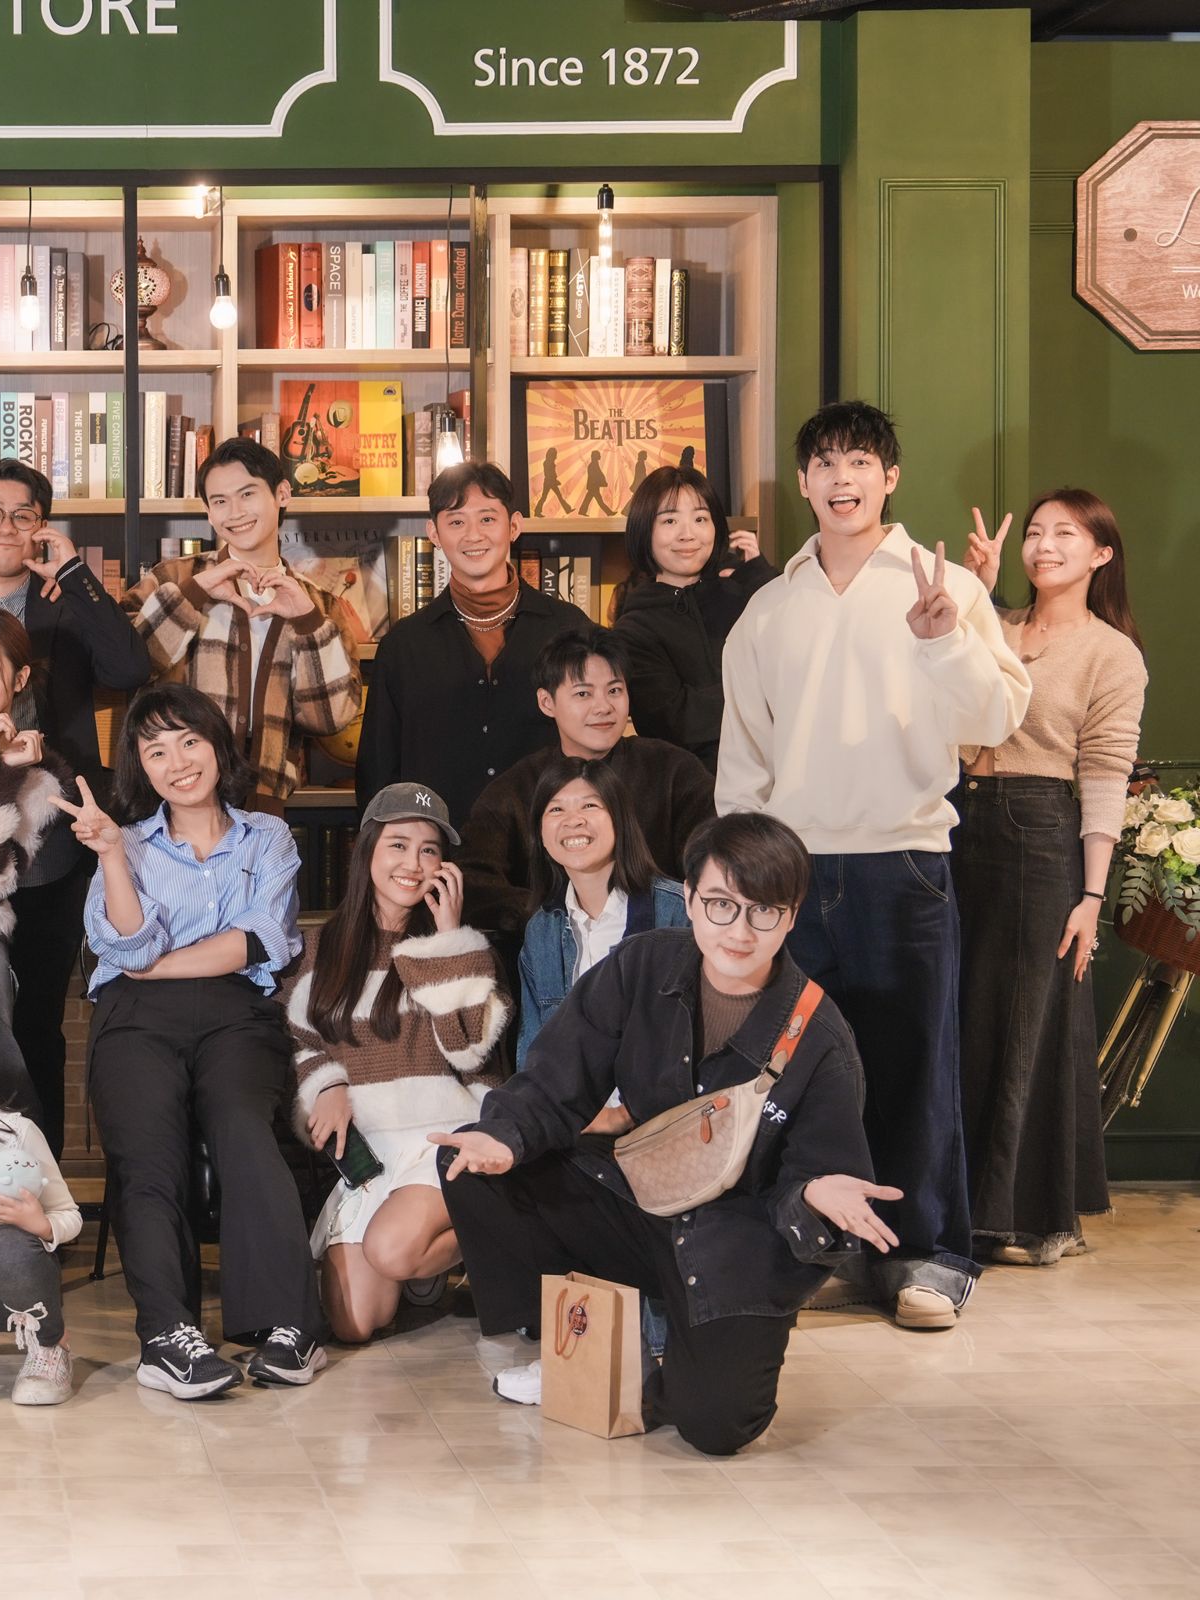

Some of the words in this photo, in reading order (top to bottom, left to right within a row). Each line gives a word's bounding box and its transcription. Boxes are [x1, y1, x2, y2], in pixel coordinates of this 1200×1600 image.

[473, 47, 584, 87] Since
[601, 47, 700, 86] 1872
[329, 246, 341, 290] SPACE
[415, 263, 427, 297] JACKSON
[57, 279, 65, 292] The
[57, 293, 65, 310] Most
[414, 298, 427, 332] MICHAEL
[451, 292, 465, 318] Dame
[57, 311, 65, 343] Excellent
[3, 401, 16, 450] BOOK
[74, 410, 83, 427] THE
[112, 400, 121, 421] FIVE
[608, 407, 625, 418] THE
[19, 404, 33, 465] ROCKY
[74, 429, 83, 458] HOTEL
[112, 422, 121, 480] CONTINENTS
[74, 459, 83, 485] BOOK
[402, 565, 412, 600] FRANK
